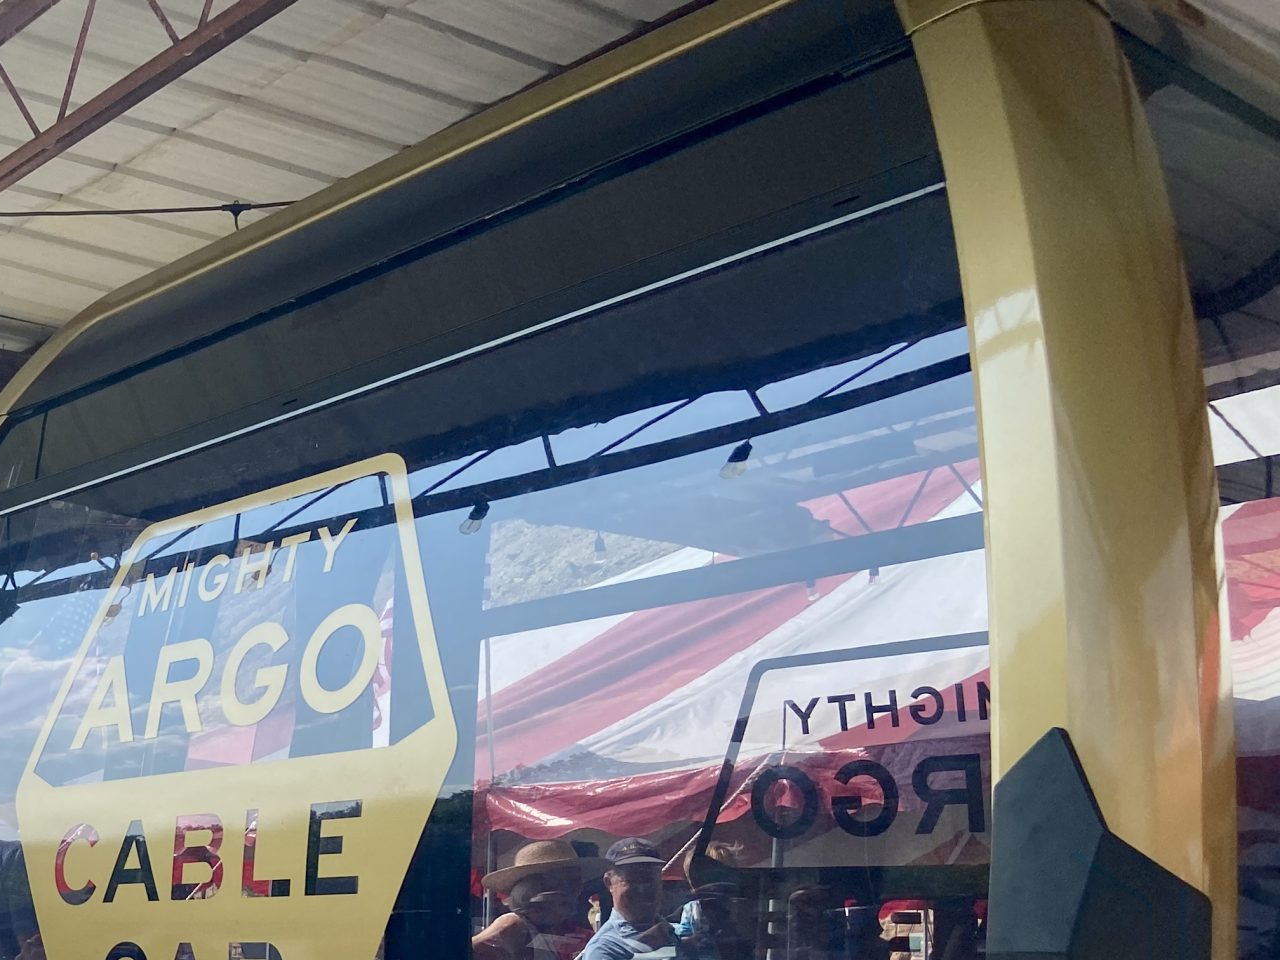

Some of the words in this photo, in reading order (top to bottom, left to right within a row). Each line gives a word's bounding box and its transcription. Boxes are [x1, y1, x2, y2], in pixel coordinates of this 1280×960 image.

[138, 518, 358, 617] MIGHTY
[70, 603, 382, 750] ARGO
[54, 799, 363, 905] CABLE
